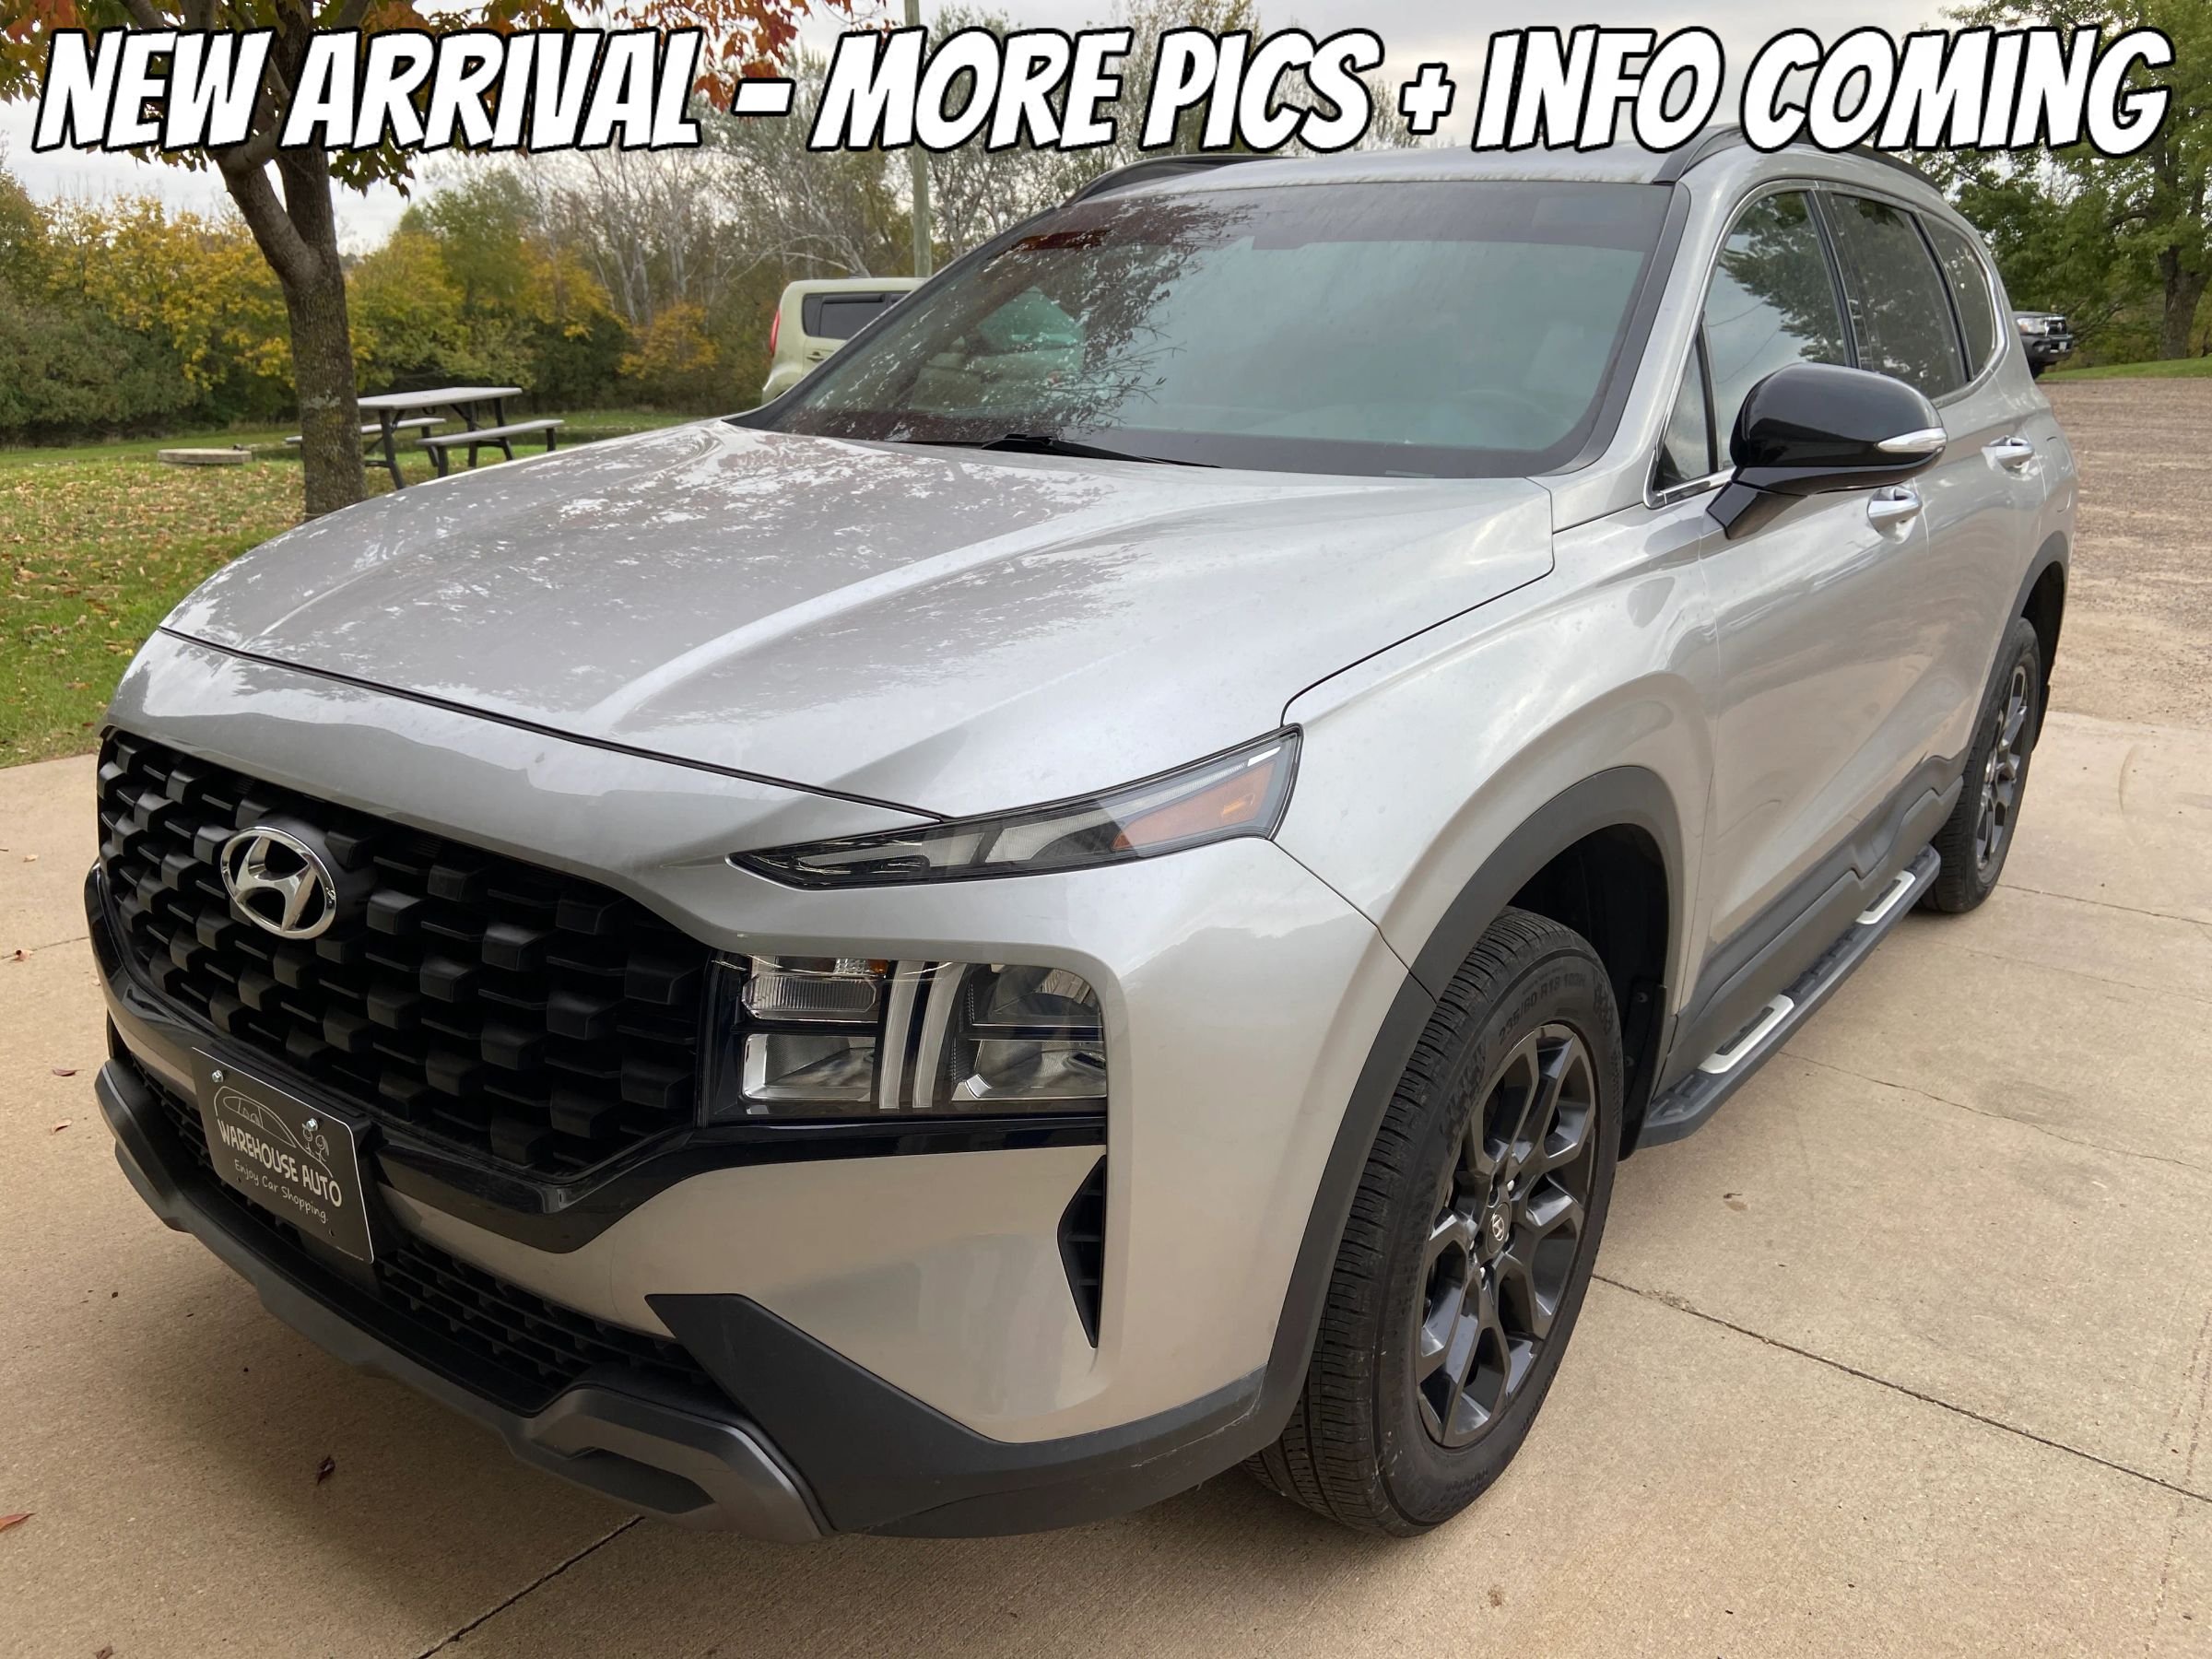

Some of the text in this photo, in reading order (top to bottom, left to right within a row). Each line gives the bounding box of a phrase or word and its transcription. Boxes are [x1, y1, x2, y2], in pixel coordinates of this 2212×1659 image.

[217, 1118, 343, 1207] WAREHOUSE AUTO
[234, 1159, 260, 1186] Enjoy
[262, 1175, 278, 1194] Car
